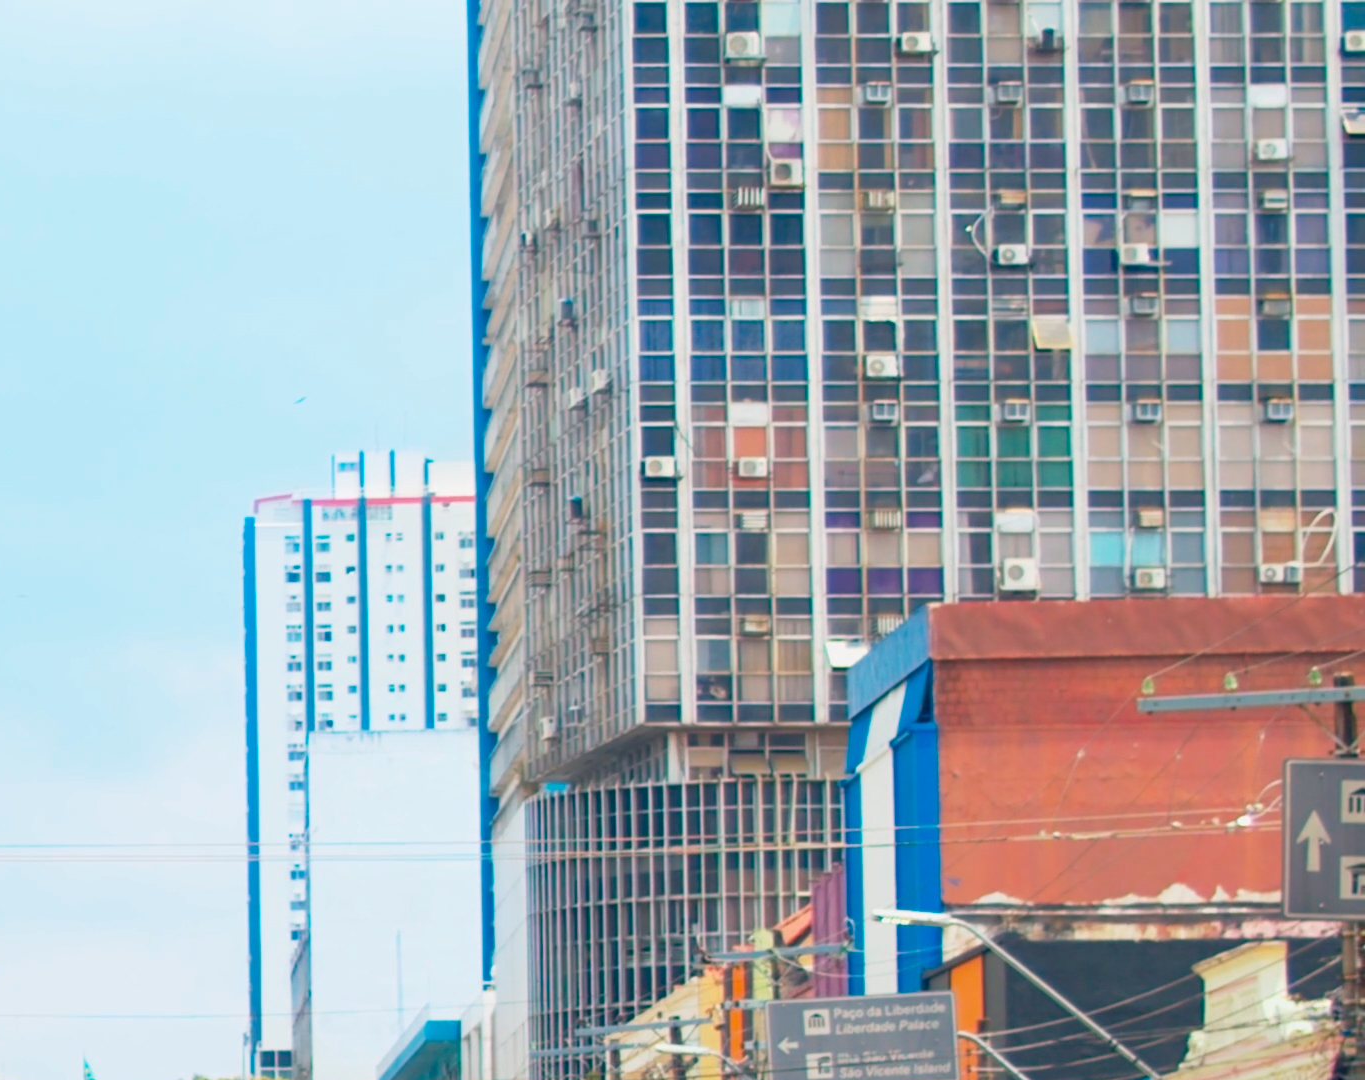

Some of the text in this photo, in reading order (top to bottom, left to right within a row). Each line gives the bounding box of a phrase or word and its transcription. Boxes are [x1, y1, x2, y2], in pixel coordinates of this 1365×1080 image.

[833, 1001, 947, 1021] Paço da Liberdade
[835, 1018, 941, 1035] Liberdade Palace
[840, 1061, 952, 1079] São Vicente Island
